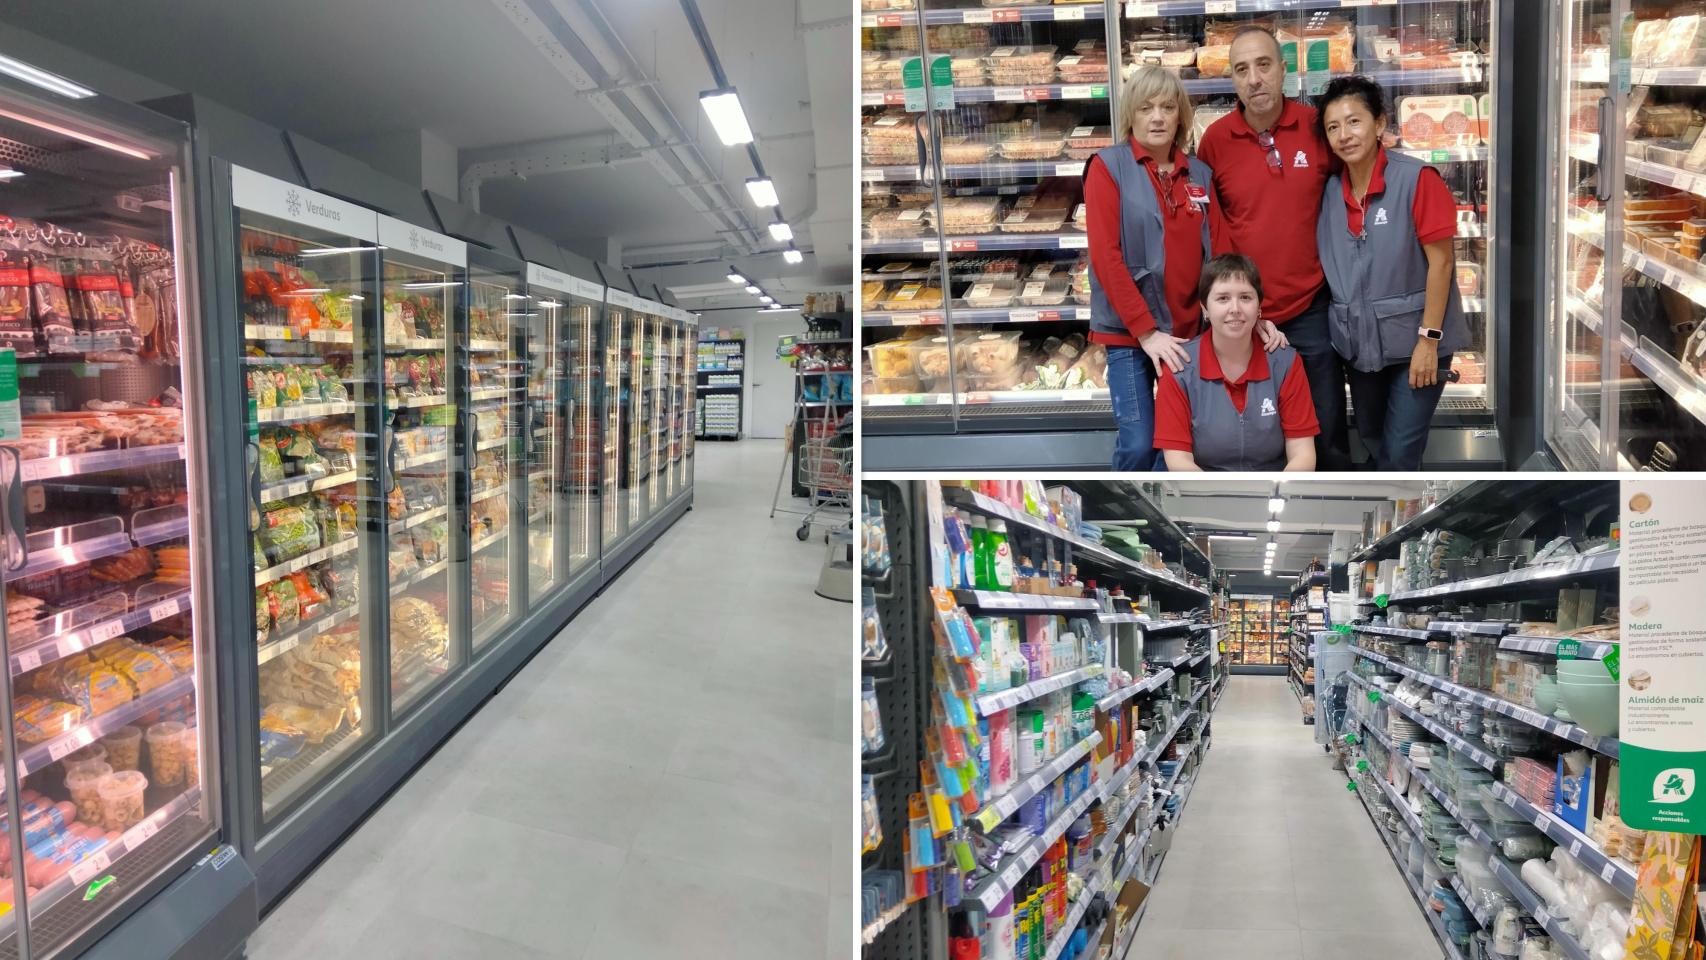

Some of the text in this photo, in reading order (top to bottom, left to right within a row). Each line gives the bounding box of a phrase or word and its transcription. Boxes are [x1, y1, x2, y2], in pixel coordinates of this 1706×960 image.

[305, 199, 341, 222] Verduras
[420, 236, 444, 252] Verduras
[1629, 518, 1660, 529] Cartón
[1628, 622, 1662, 631] Madera
[1628, 695, 1705, 704] Almidón de maíz
